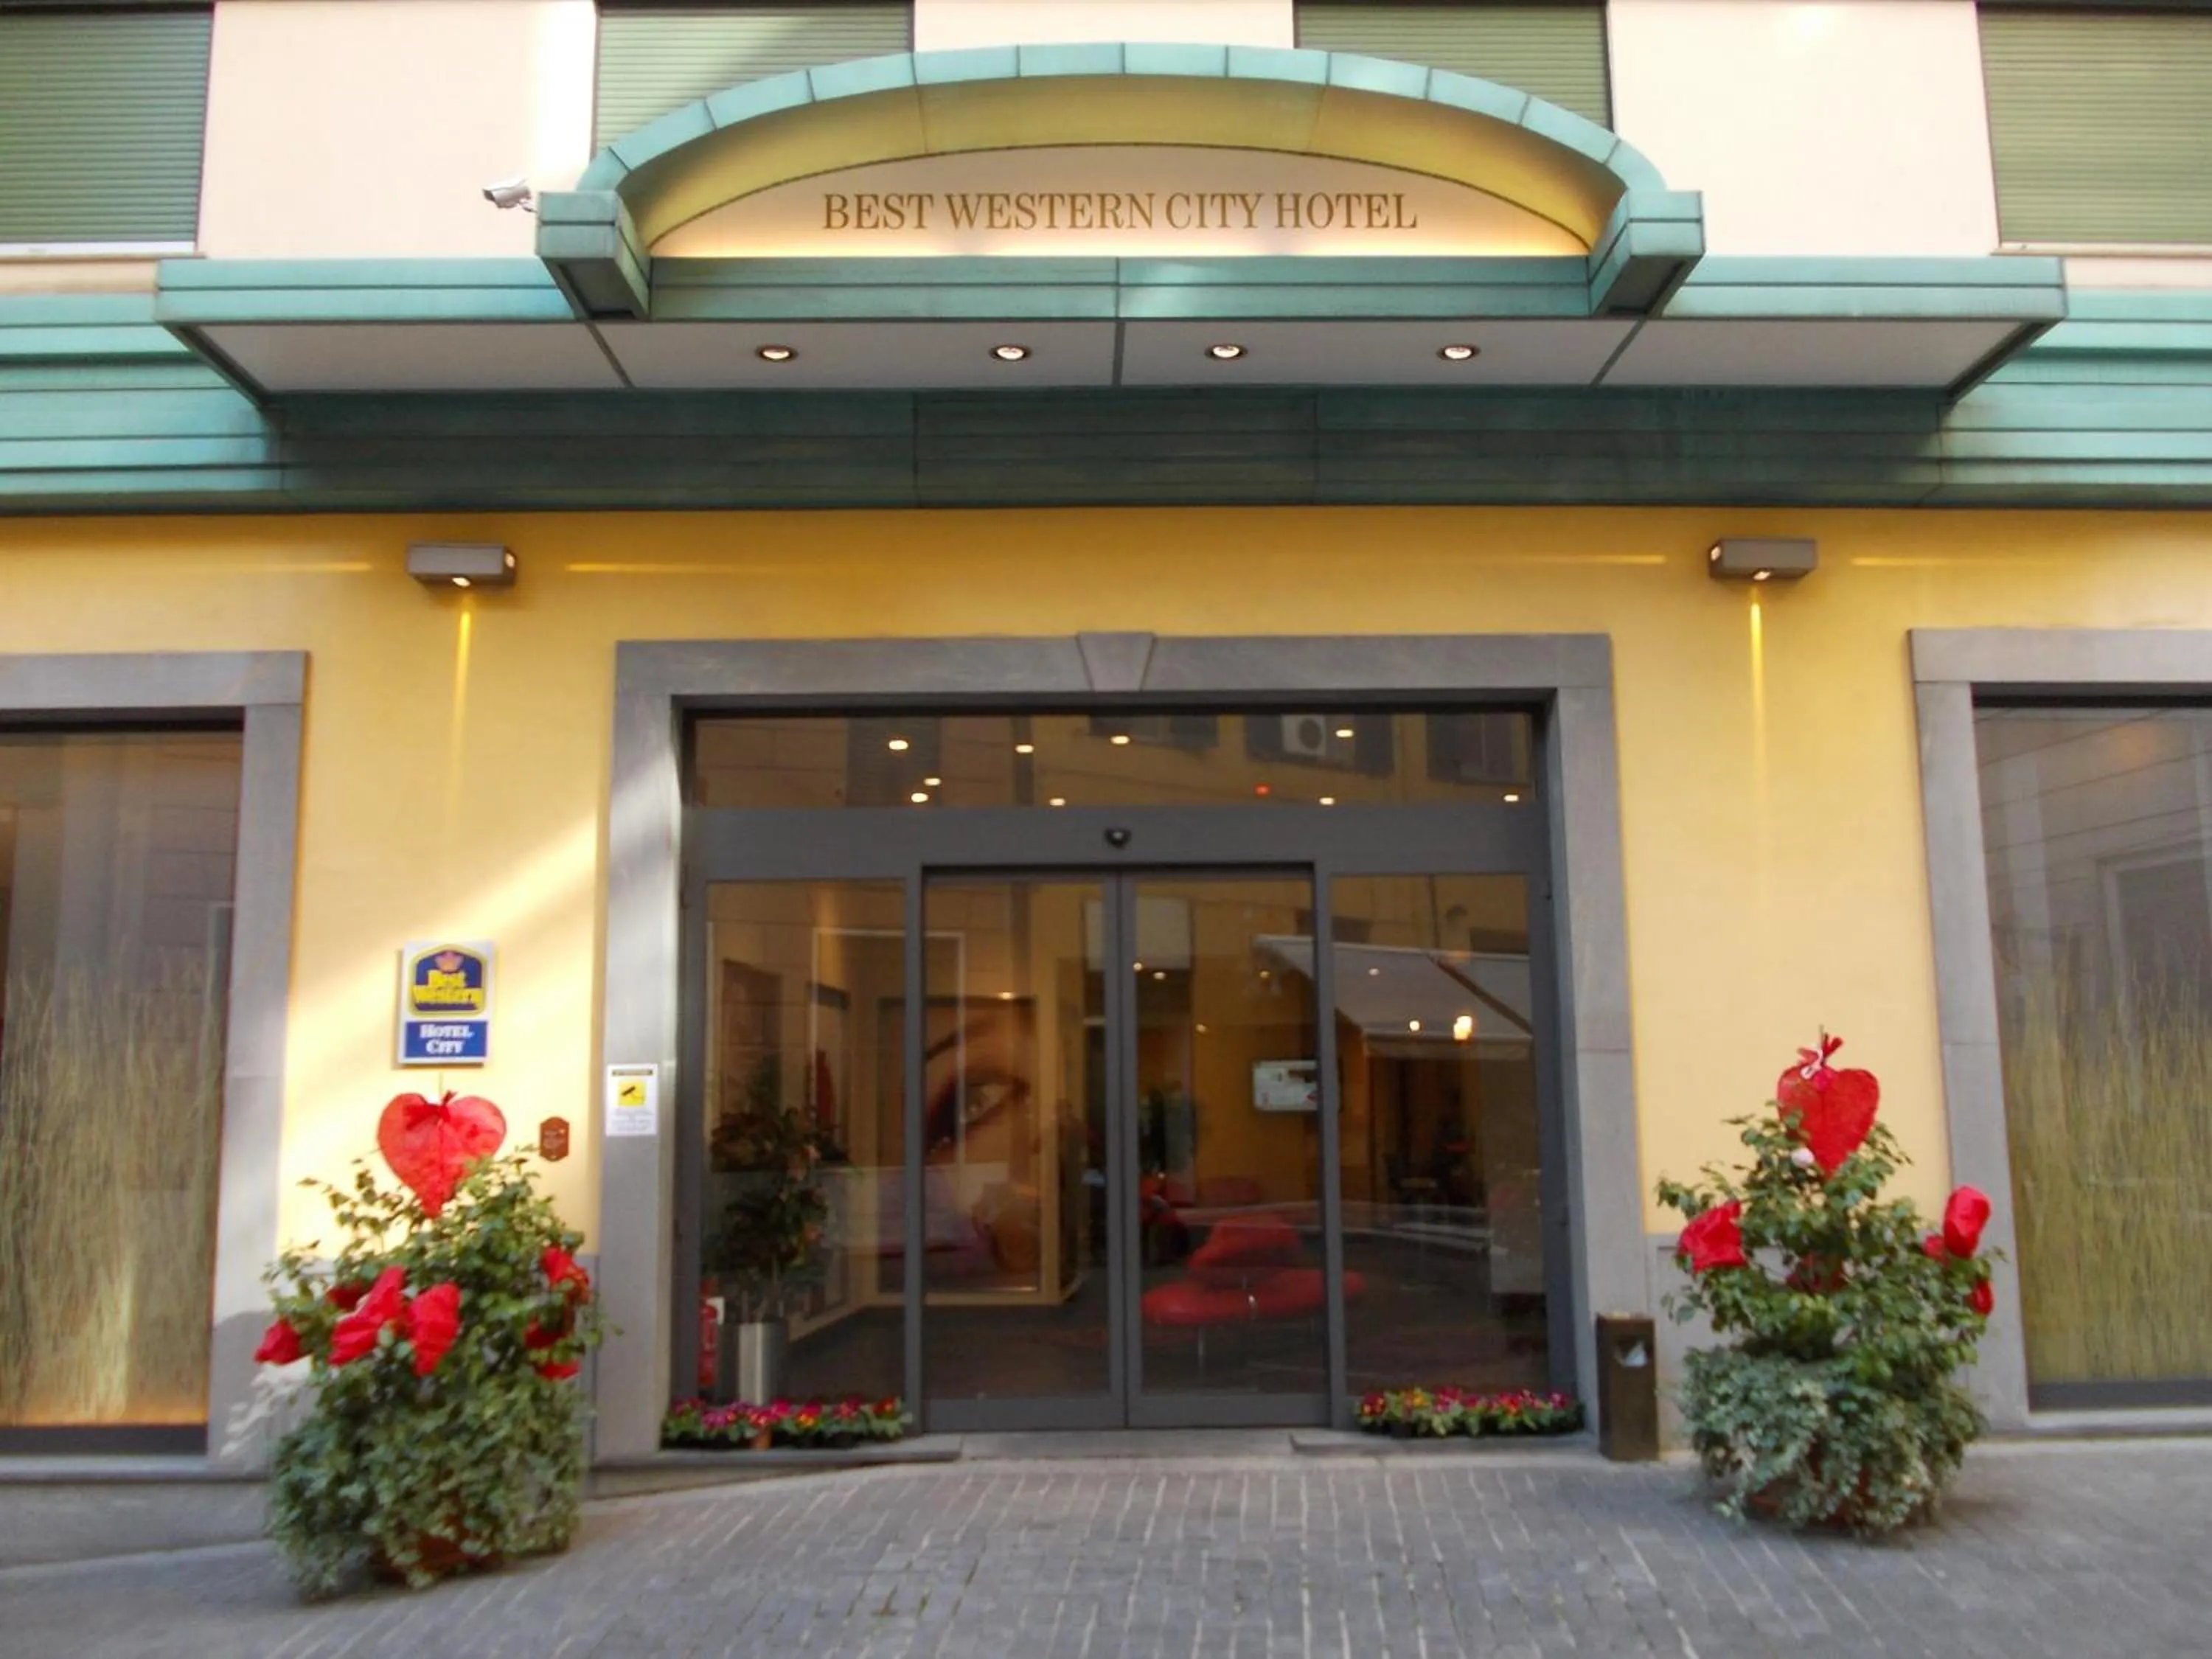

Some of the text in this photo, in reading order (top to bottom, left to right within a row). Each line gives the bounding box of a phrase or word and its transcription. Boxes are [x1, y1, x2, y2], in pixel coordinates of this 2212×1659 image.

[822, 193, 1418, 229] BEST WESTERN CITY HOTEL
